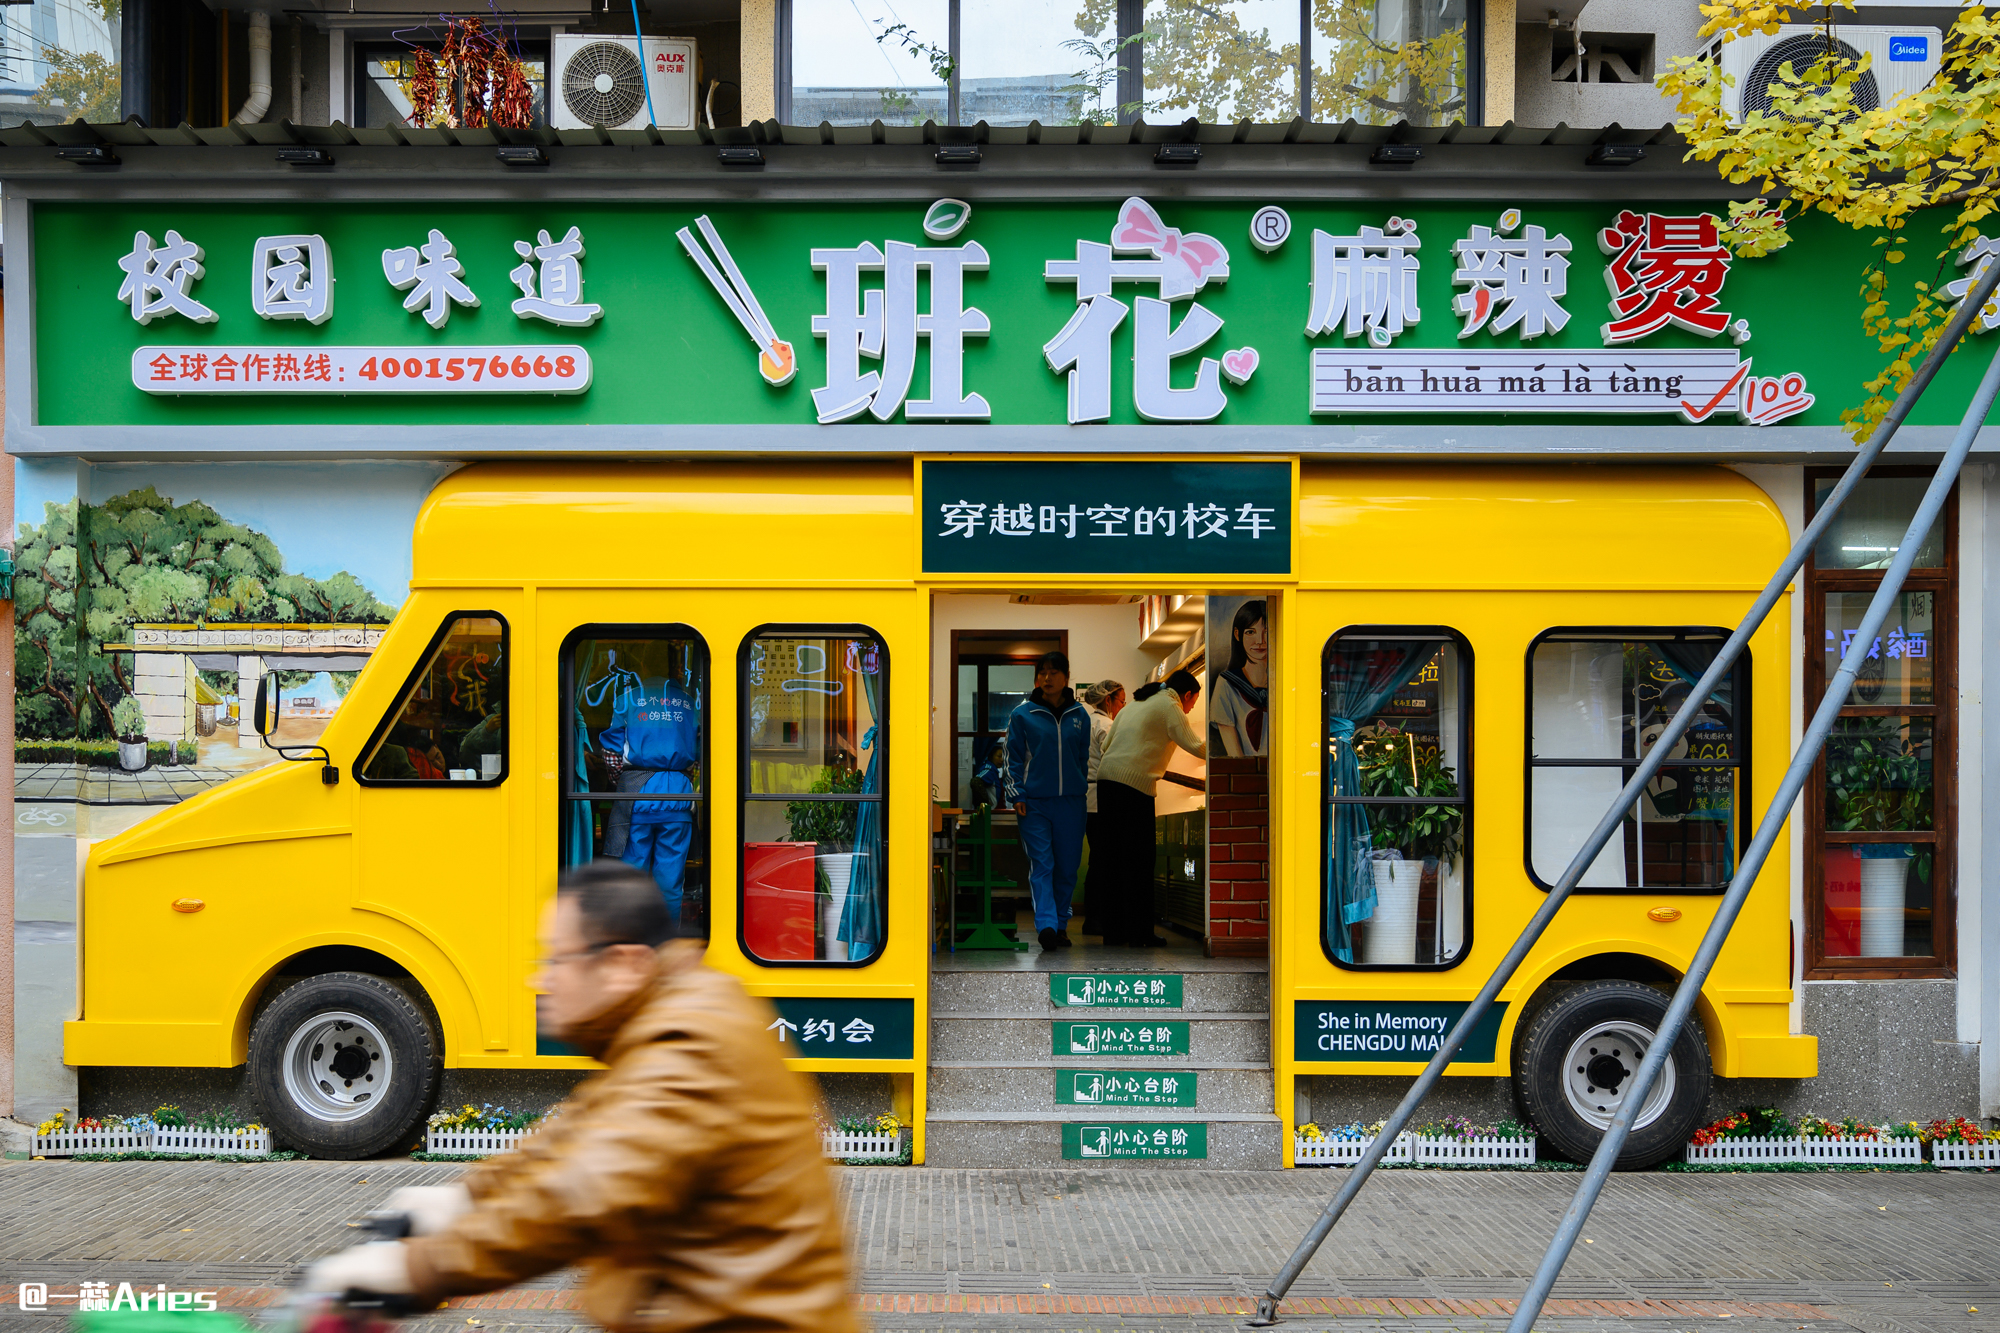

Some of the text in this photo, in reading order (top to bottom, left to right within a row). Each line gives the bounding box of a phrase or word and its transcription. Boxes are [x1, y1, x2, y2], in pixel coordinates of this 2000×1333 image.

[1893, 44, 1925, 54] Midea
[655, 53, 686, 63] AUX
[656, 64, 685, 73] 奥克斯
[118, 226, 604, 329] 校园味道
[811, 236, 1230, 424] 班花
[1344, 362, 1683, 399] bān huā má là tàng
[938, 499, 1276, 541] 穿越时空的校车
[1097, 979, 1166, 996] 小心台阶
[1097, 996, 1166, 1005] Mind The Step
[766, 1017, 875, 1043] 个约会
[1318, 1012, 1448, 1034] She in Memory
[1101, 1027, 1172, 1043] 小心台阶
[1317, 1034, 1462, 1051] CHENGDU MA
[1128, 1044, 1145, 1052] The
[1149, 1044, 1172, 1052] Step
[1106, 1076, 1179, 1094] 小心台阶
[1106, 1094, 1178, 1104] Mind The Step
[1113, 1128, 1188, 1146] 小心台阶
[1113, 1147, 1188, 1156] Mind The Step
